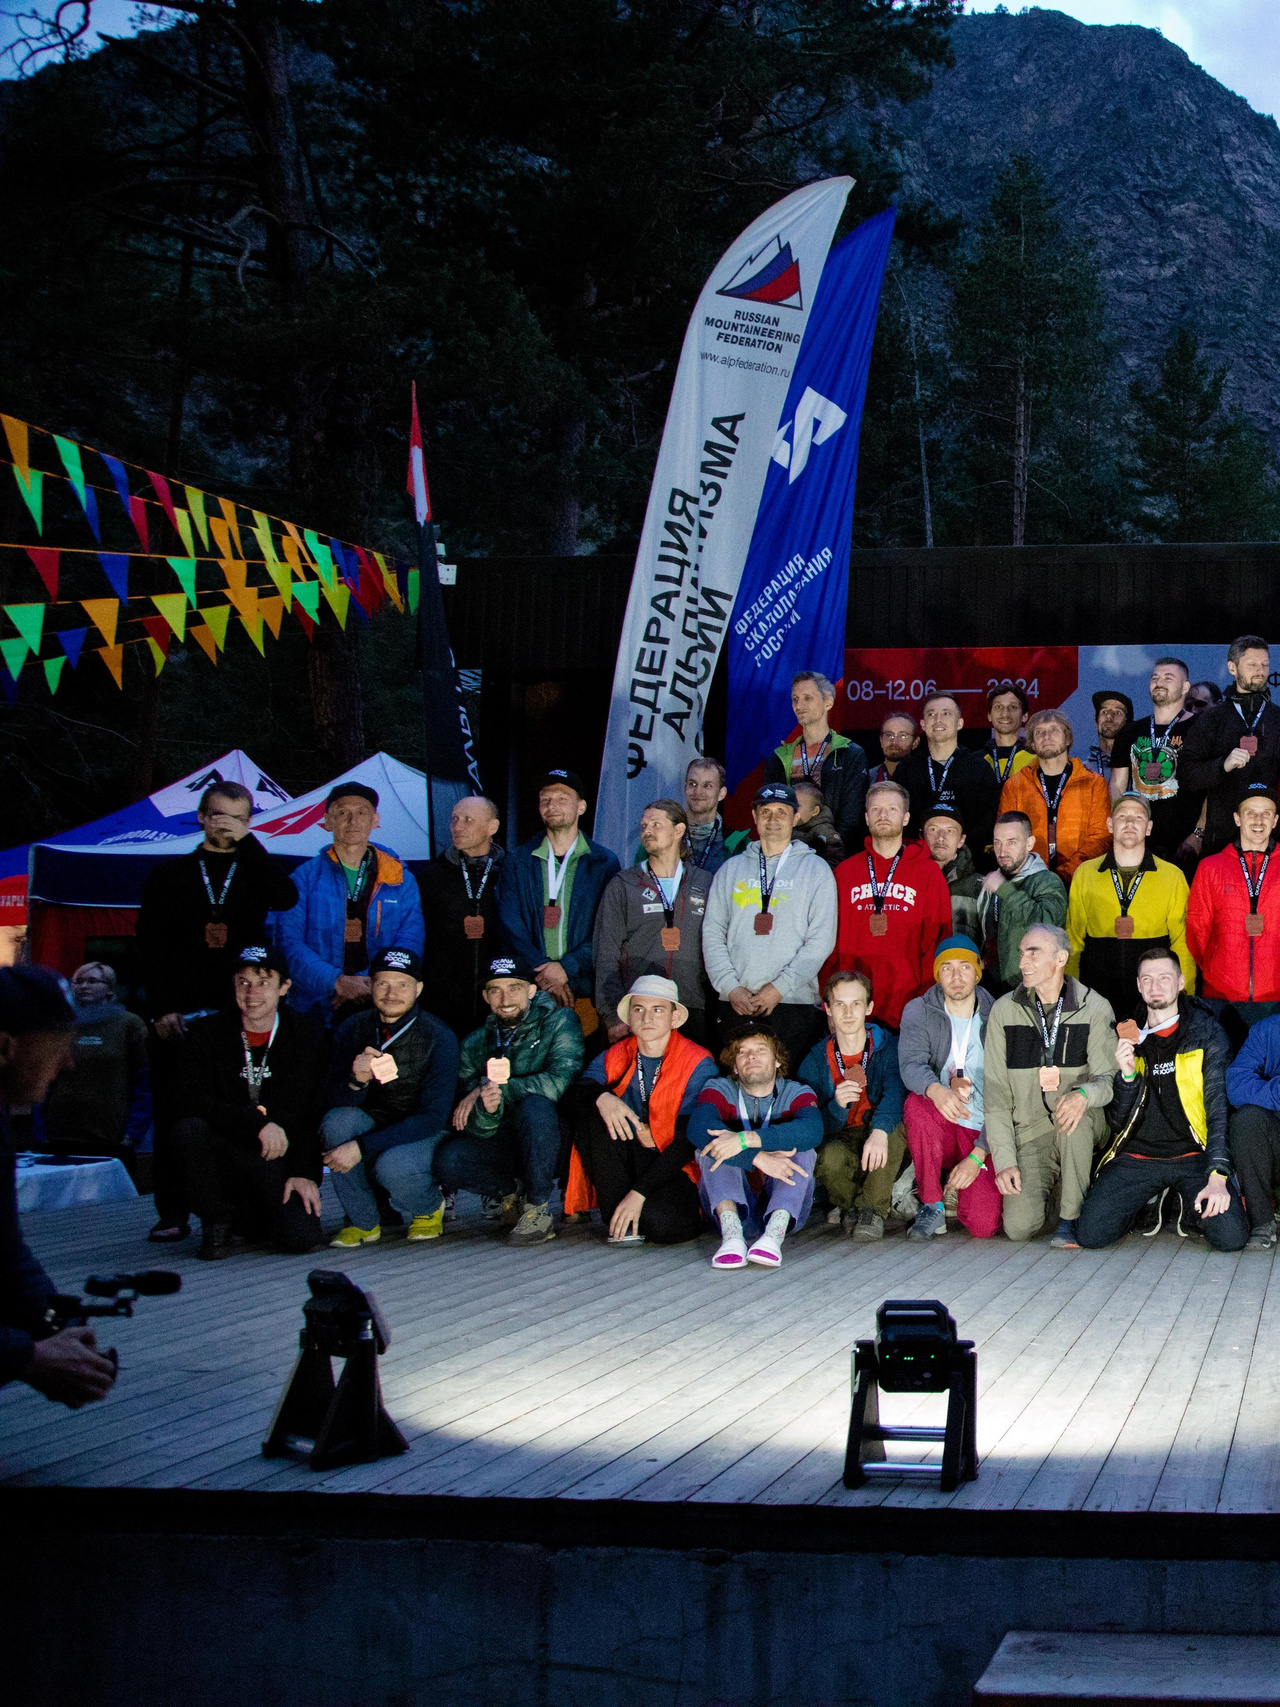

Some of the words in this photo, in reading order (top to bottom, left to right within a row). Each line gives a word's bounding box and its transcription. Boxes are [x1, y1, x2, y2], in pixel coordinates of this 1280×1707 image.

[704, 316, 801, 344] MOUNTAINEERING
[734, 310, 780, 327] RUSSIAN
[716, 332, 783, 354] FEDERATION
[734, 553, 806, 637] ФЕДЕРАЦИЯ
[851, 882, 917, 906] CHICE
